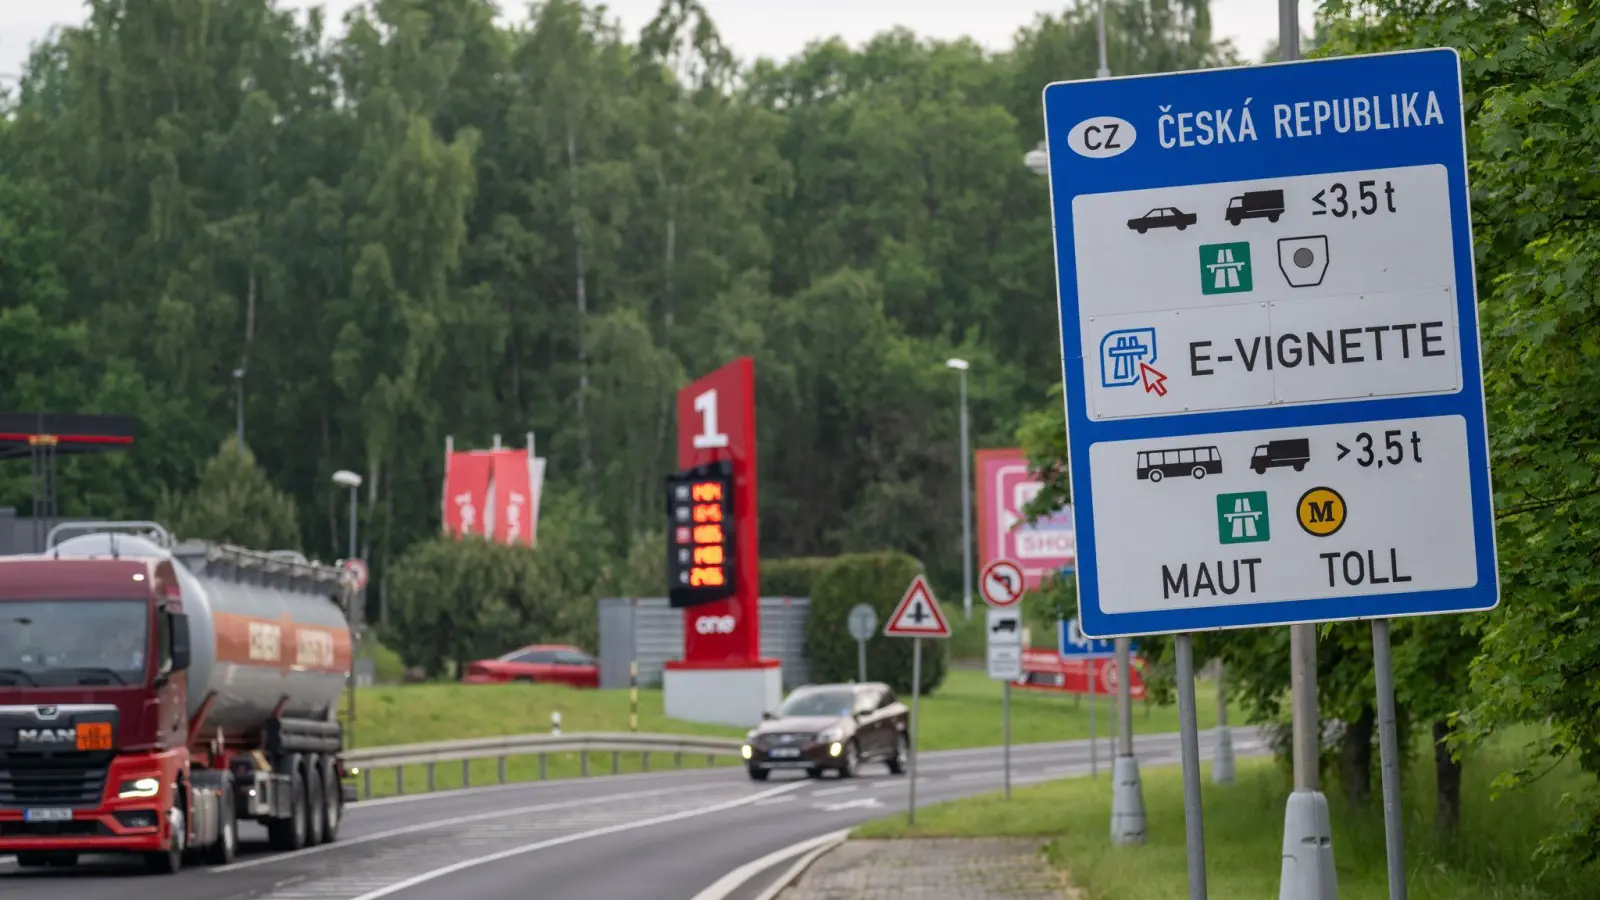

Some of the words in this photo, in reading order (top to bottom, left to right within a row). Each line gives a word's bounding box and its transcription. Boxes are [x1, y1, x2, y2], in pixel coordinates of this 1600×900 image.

[1158, 97, 1258, 149] ČESKÁ
[1273, 90, 1445, 139] REPUBLIKA
[1083, 124, 1121, 151] CZ
[1189, 321, 1446, 377] E-VIGNETTE
[693, 389, 729, 449] 1
[1308, 500, 1336, 523] M
[1023, 531, 1074, 552] SHO
[1161, 558, 1262, 600] MAUT
[1319, 547, 1412, 588] TOLL
[695, 615, 736, 634] one
[18, 728, 76, 743] MAN
